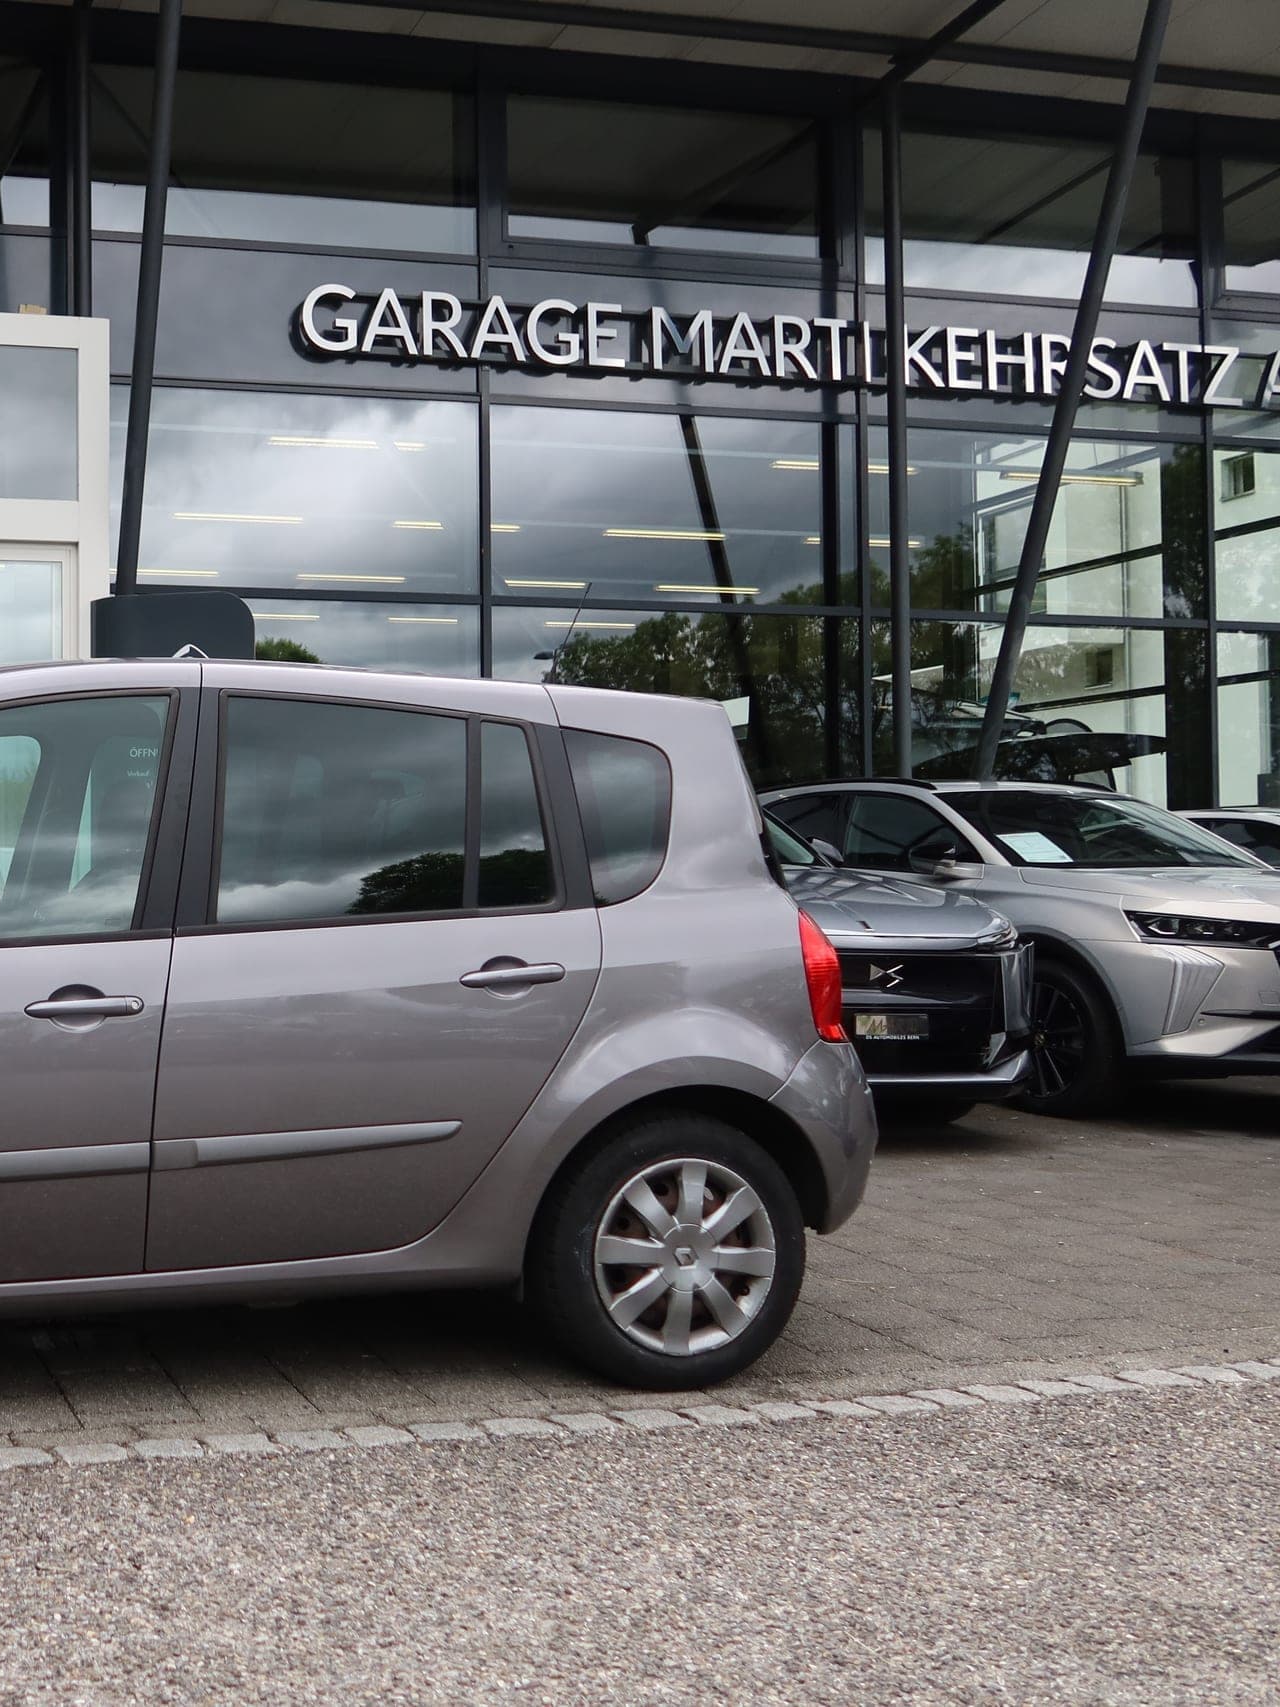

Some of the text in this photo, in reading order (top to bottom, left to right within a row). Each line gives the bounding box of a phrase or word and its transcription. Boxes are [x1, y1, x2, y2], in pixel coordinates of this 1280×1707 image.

[301, 282, 627, 369] GARAGE
[650, 305, 872, 384] MARTI
[129, 745, 159, 758] ÖFFN
